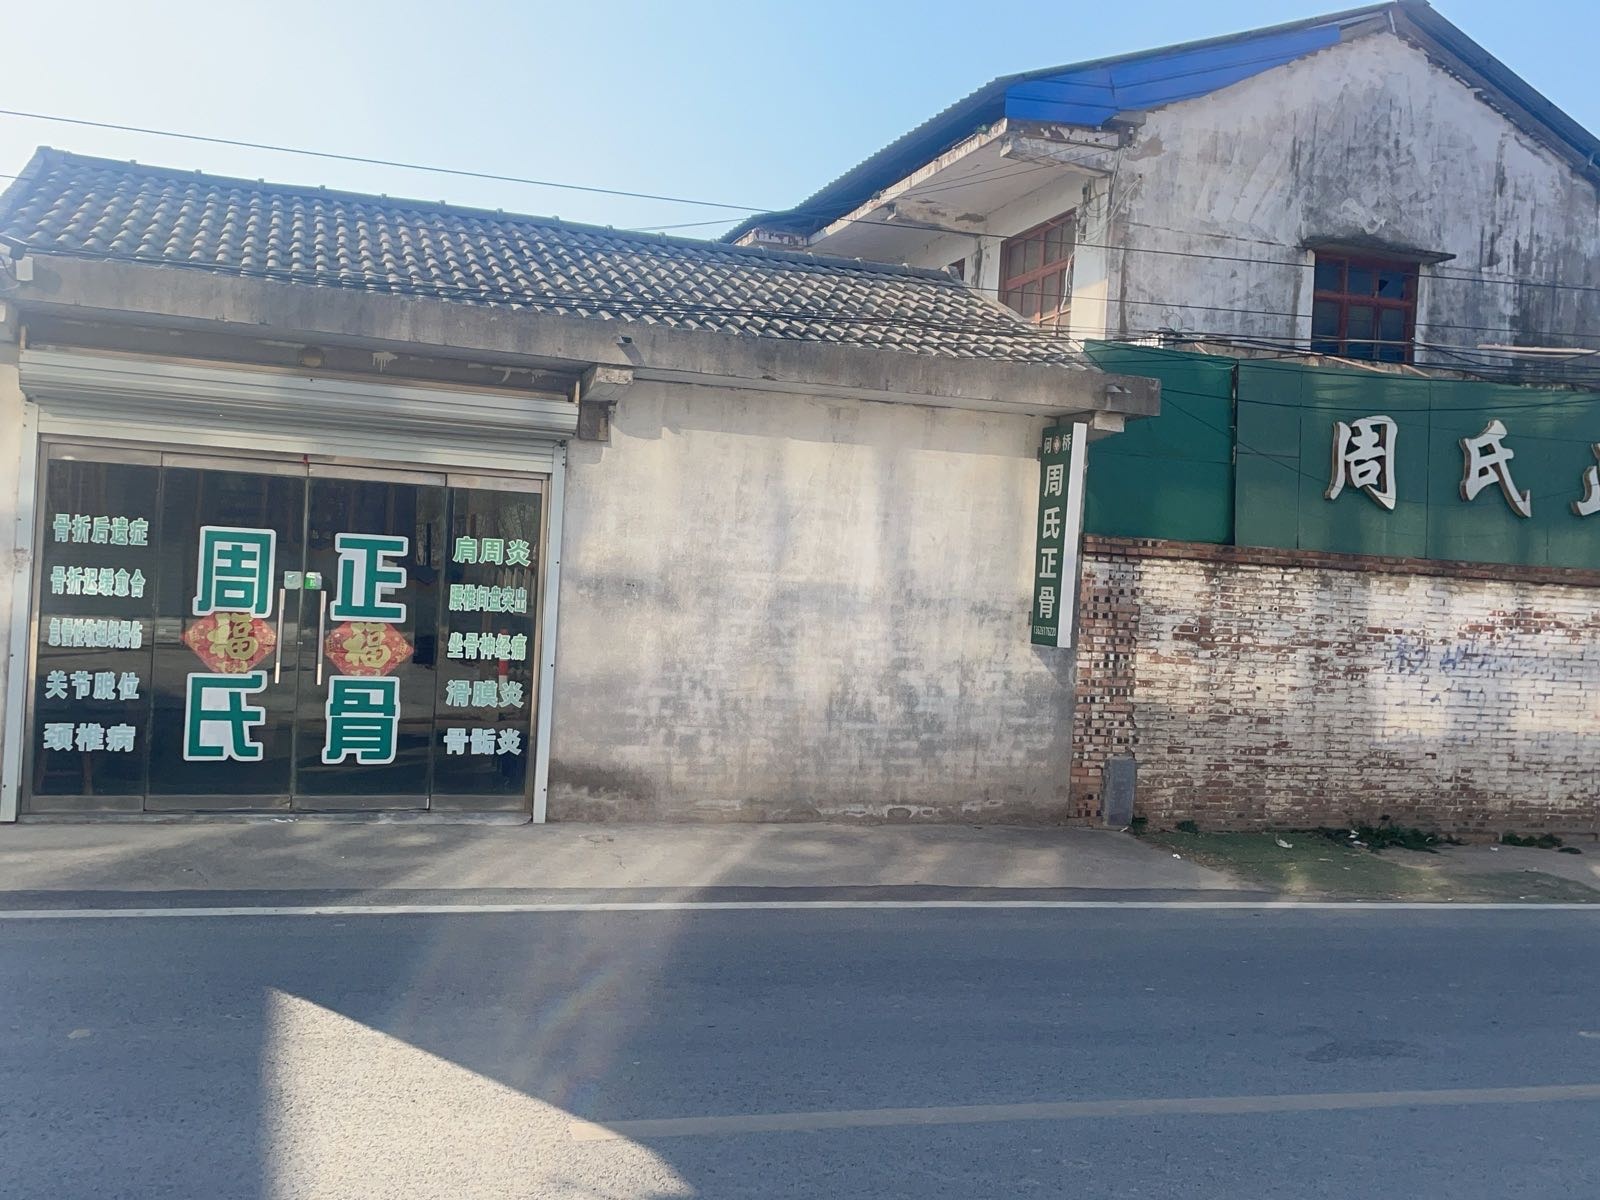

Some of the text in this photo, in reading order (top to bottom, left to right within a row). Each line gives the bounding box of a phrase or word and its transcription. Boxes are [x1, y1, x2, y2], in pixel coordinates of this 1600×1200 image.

[53, 514, 149, 546] 骨折后遗症
[1038, 463, 1064, 619] 周氏正骨
[452, 536, 531, 567] 肩周炎
[50, 566, 146, 598] 骨折迟缓愈合
[449, 584, 528, 614] 腰椎间盘突出
[183, 525, 277, 763] 周氏
[321, 532, 409, 766] 正骨
[447, 631, 528, 661] 坐骨神经痛
[44, 671, 140, 701] 关节脱位
[445, 680, 525, 708] 滑膜炎
[43, 723, 136, 752] 颈椎病
